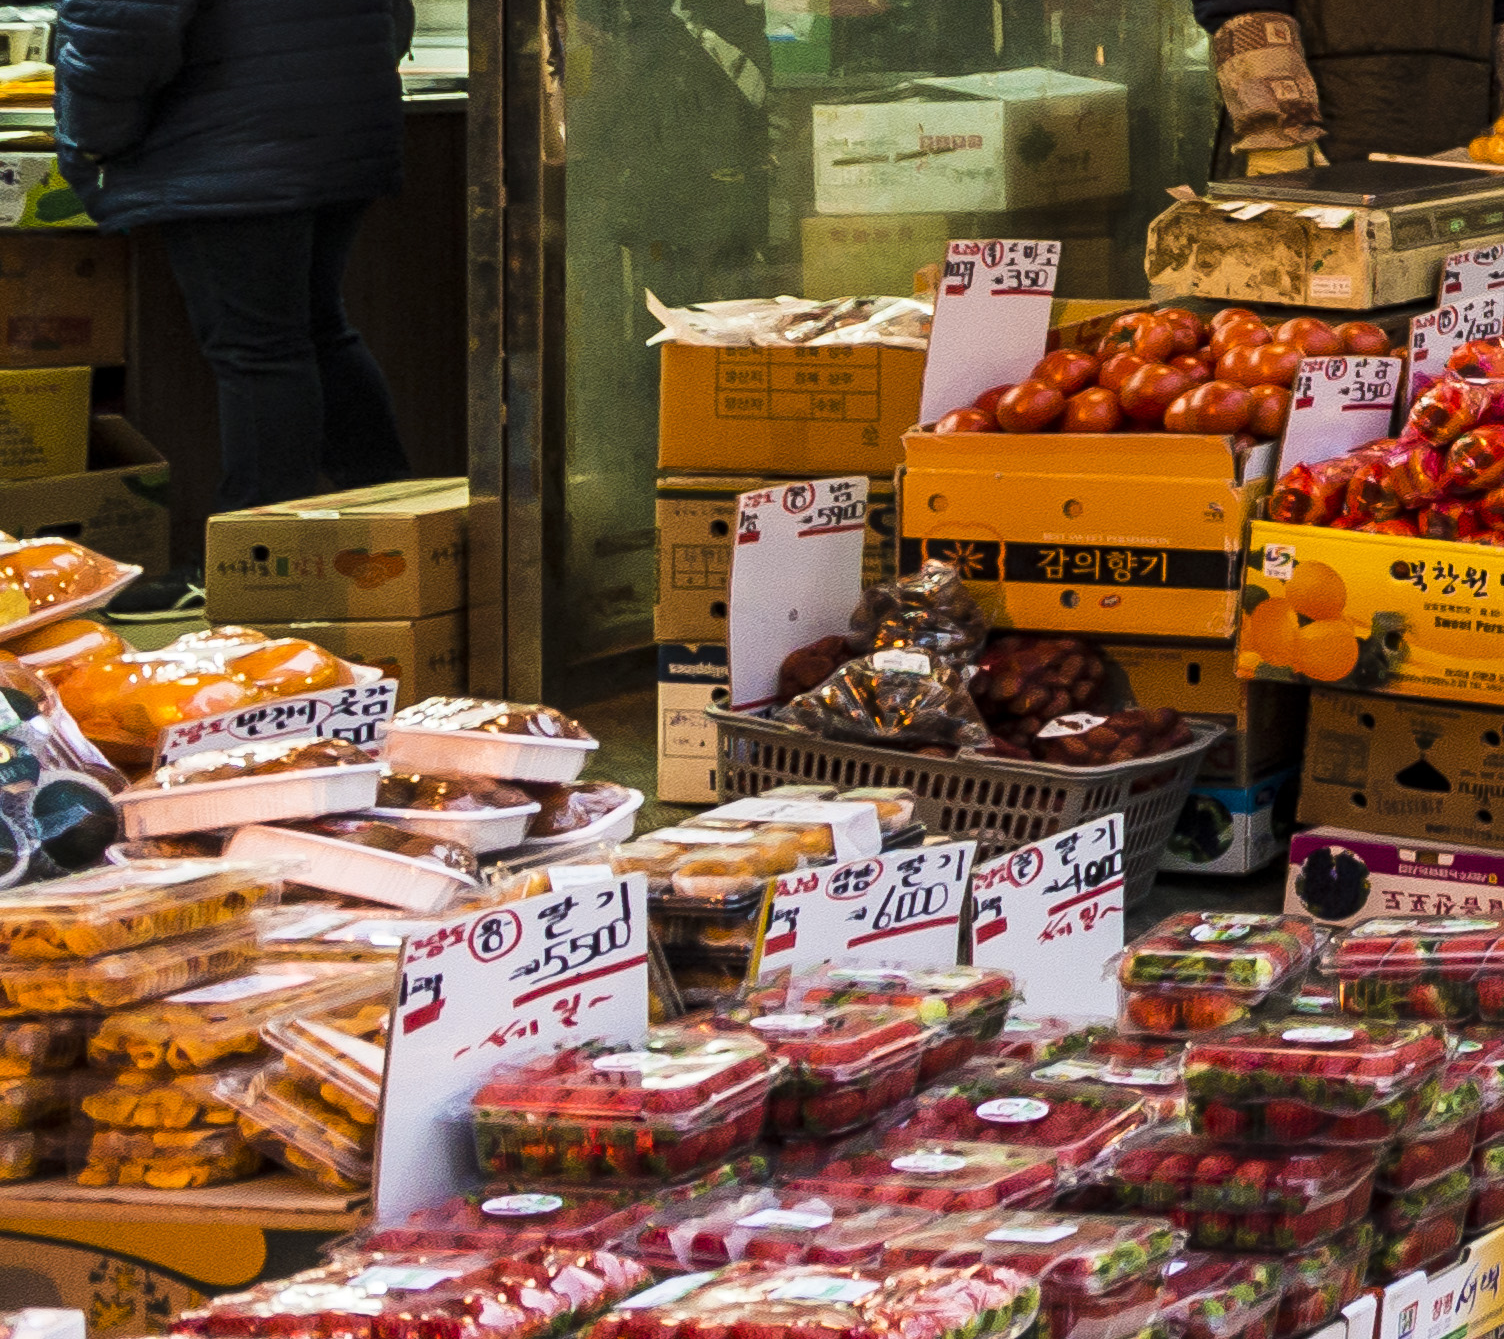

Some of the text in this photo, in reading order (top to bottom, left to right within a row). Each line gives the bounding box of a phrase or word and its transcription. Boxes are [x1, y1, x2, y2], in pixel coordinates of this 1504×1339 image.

[1037, 547, 1168, 584] 감의향기
[236, 699, 318, 737] 반건시
[332, 685, 394, 717] 곶감
[1054, 818, 1116, 866] 딸기
[896, 849, 965, 888] 딸기
[537, 881, 632, 940] 딸기
